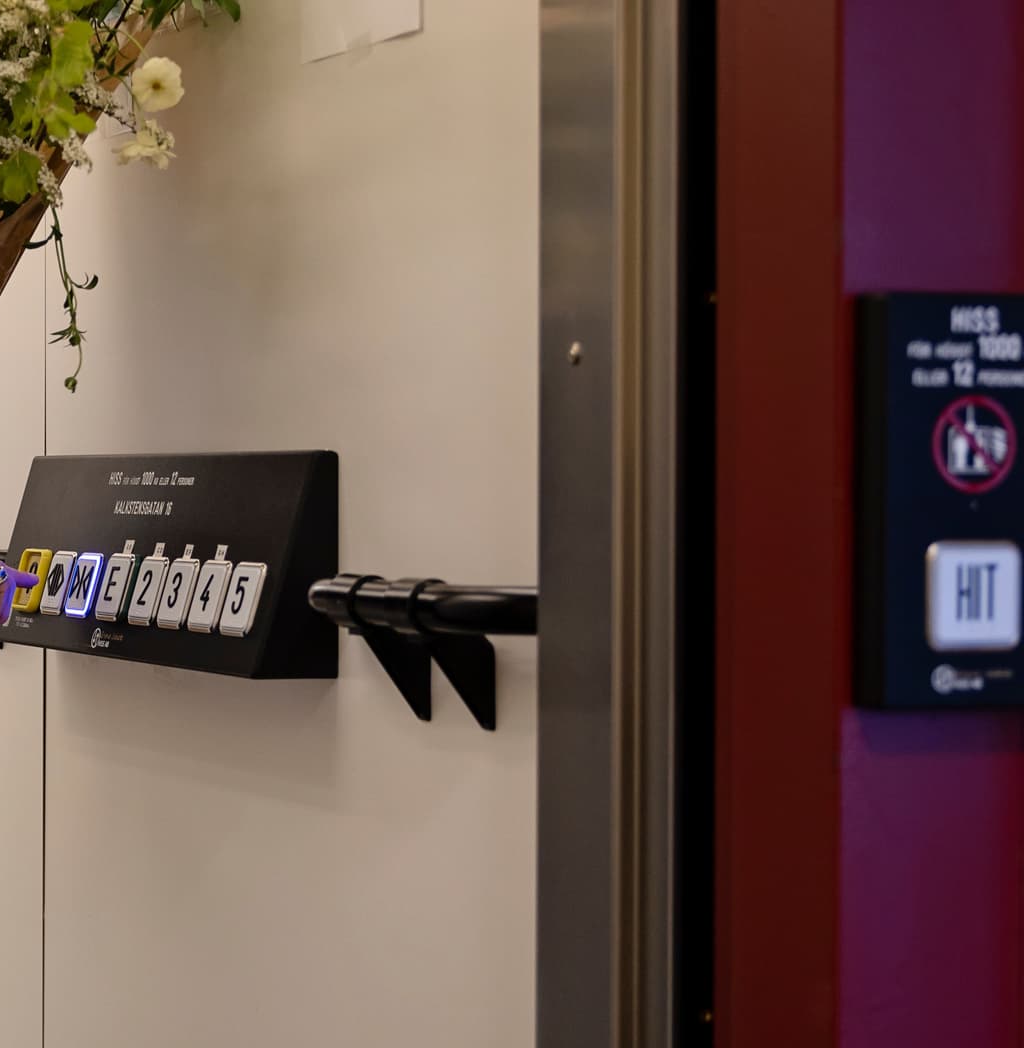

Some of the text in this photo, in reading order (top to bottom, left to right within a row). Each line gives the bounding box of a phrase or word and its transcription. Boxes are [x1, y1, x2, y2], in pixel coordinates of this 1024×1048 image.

[950, 306, 999, 333] HISS
[978, 332, 1022, 361] 1000
[952, 359, 974, 388] 12
[108, 472, 123, 485] HISS
[141, 472, 155, 485] 1000
[170, 472, 178, 485] 12
[114, 501, 173, 515] KALKSTENSGATAN 16
[103, 566, 249, 615] E 2 3 4 5
[956, 563, 998, 621] HIT
